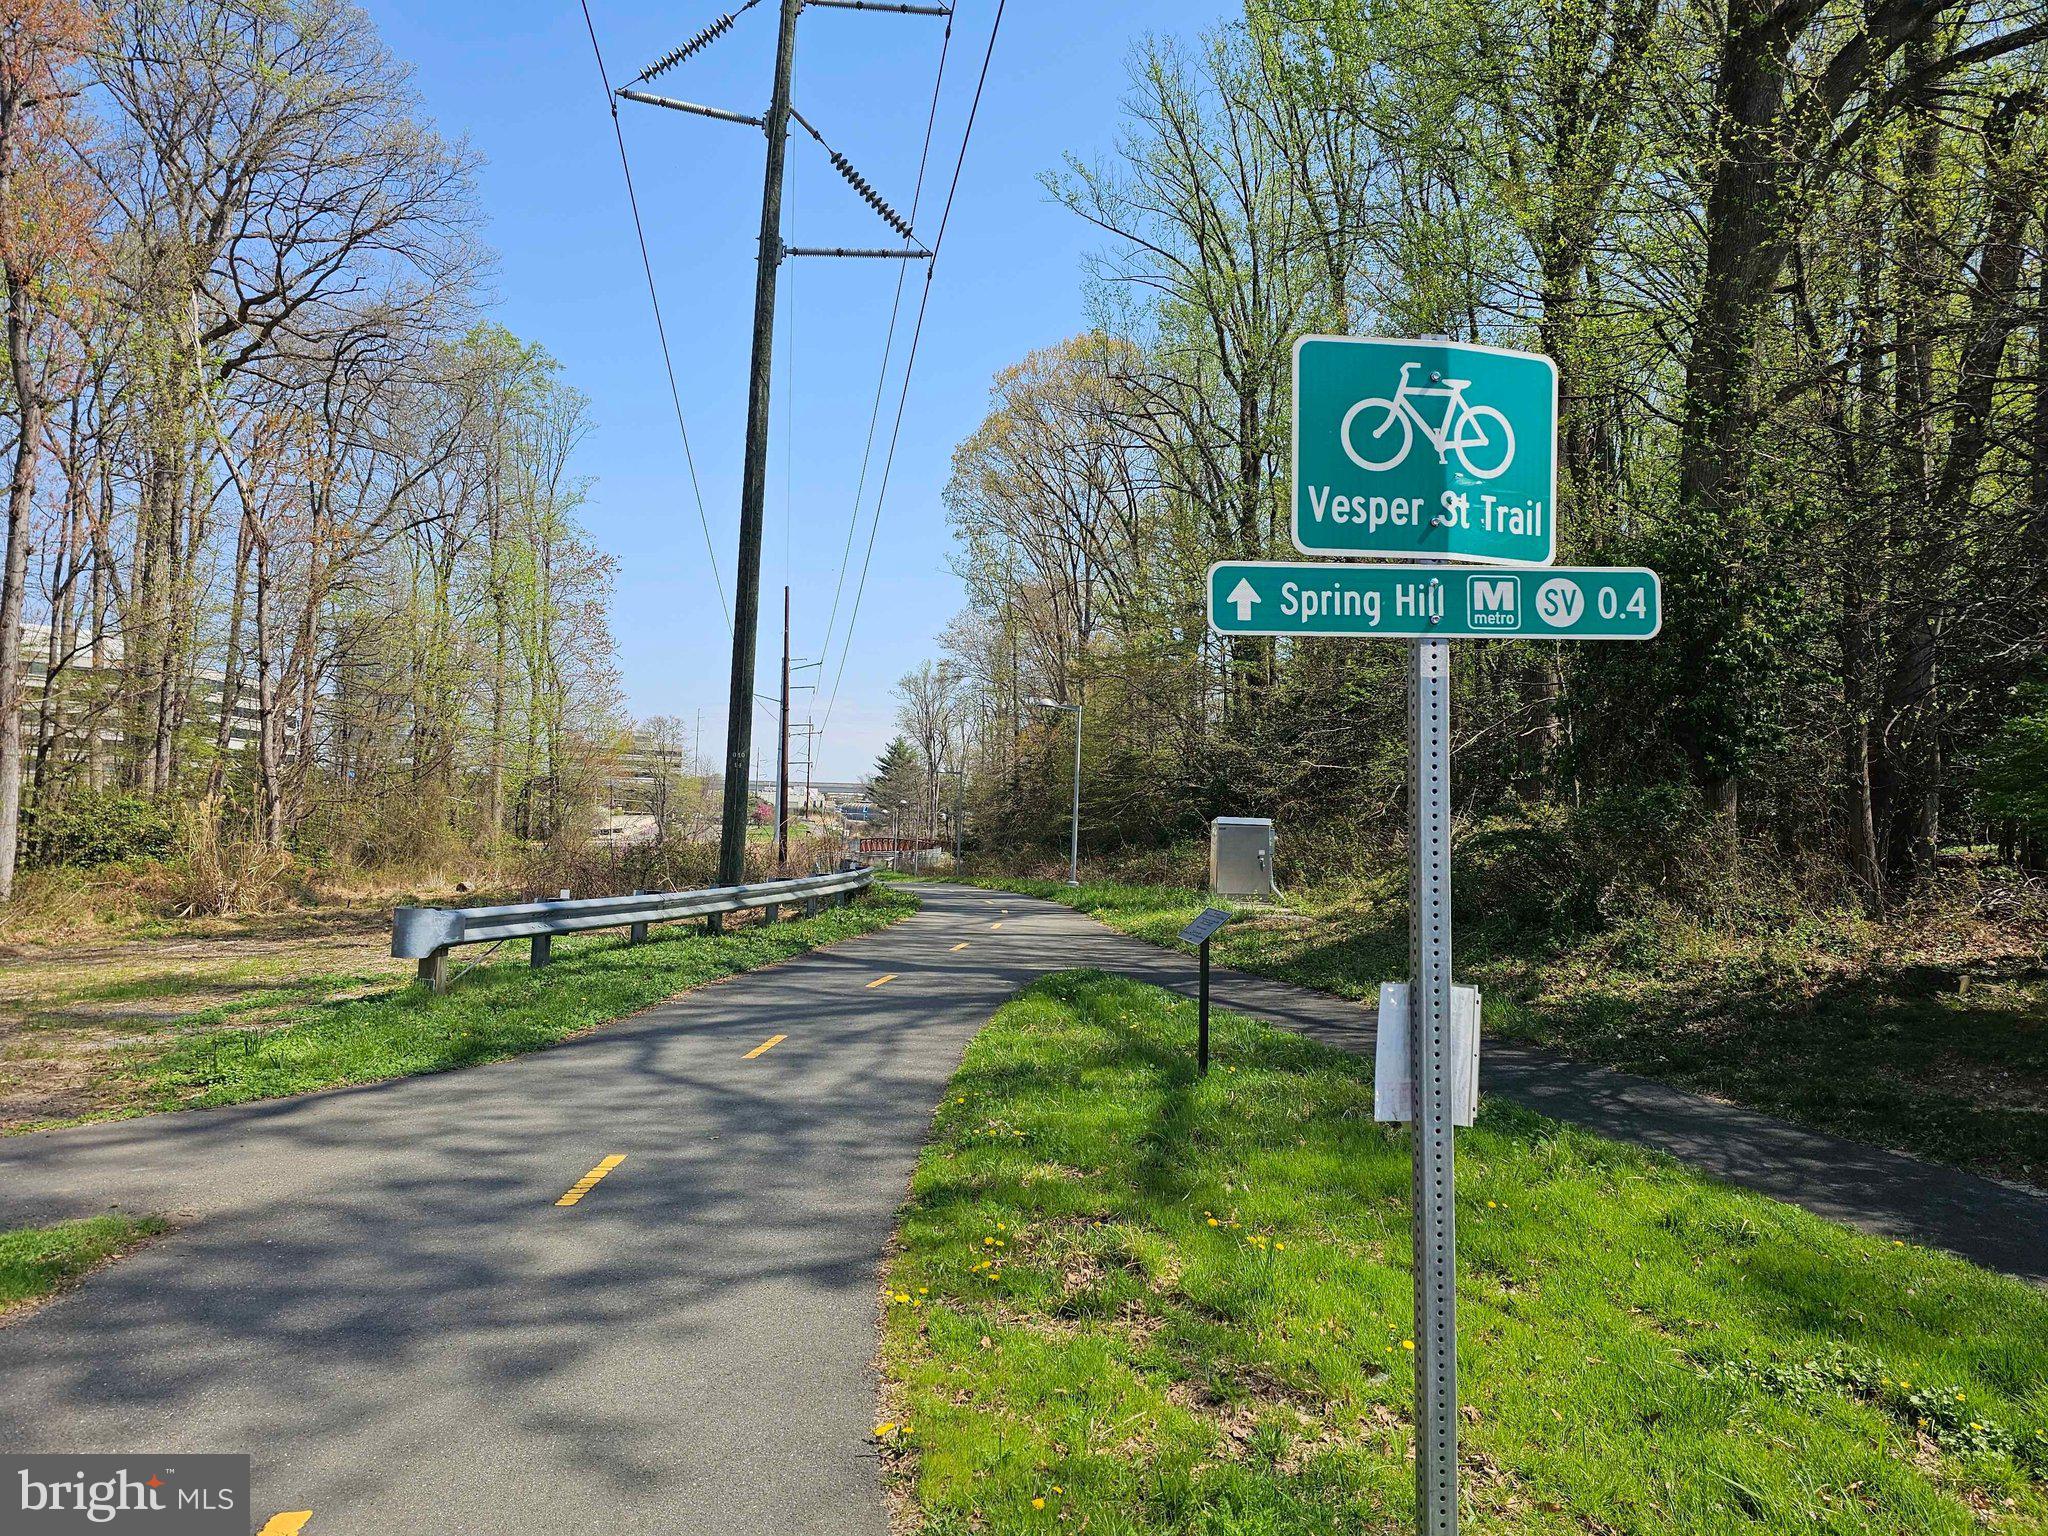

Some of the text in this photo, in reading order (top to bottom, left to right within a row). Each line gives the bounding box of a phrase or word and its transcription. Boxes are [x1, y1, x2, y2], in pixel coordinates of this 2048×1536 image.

[1308, 485, 1542, 537] Vesper St Trail
[1280, 581, 1444, 627] Spring Hill
[1473, 581, 1514, 611] M
[1543, 588, 1577, 617] SV
[1597, 586, 1647, 619] 0.4
[1474, 613, 1515, 626] metro
